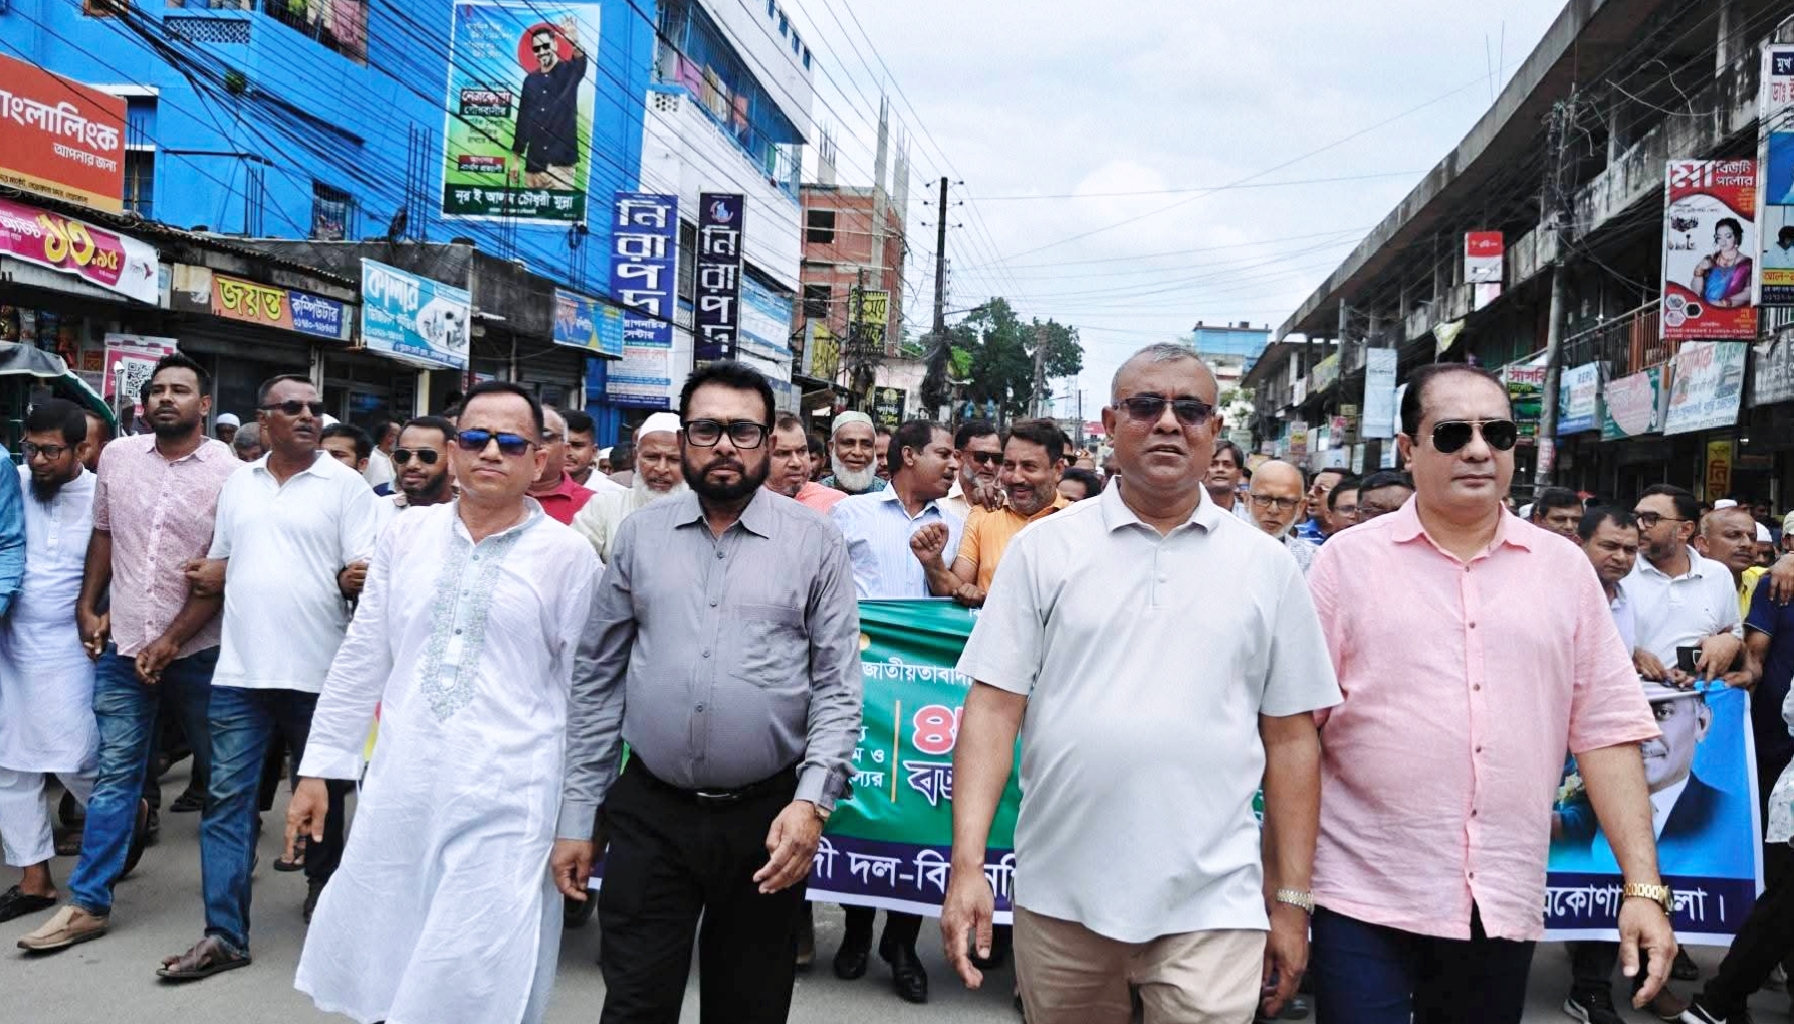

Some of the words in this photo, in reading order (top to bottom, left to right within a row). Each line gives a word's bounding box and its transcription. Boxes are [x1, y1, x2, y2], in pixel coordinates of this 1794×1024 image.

[53, 143, 94, 166] আপনার
[95, 156, 117, 172] জন্য
[1666, 160, 1716, 188] মা
[614, 199, 671, 315] নিরাপদ
[216, 277, 286, 321] জয়ন্ত
[699, 225, 739, 353] নিরাপদ
